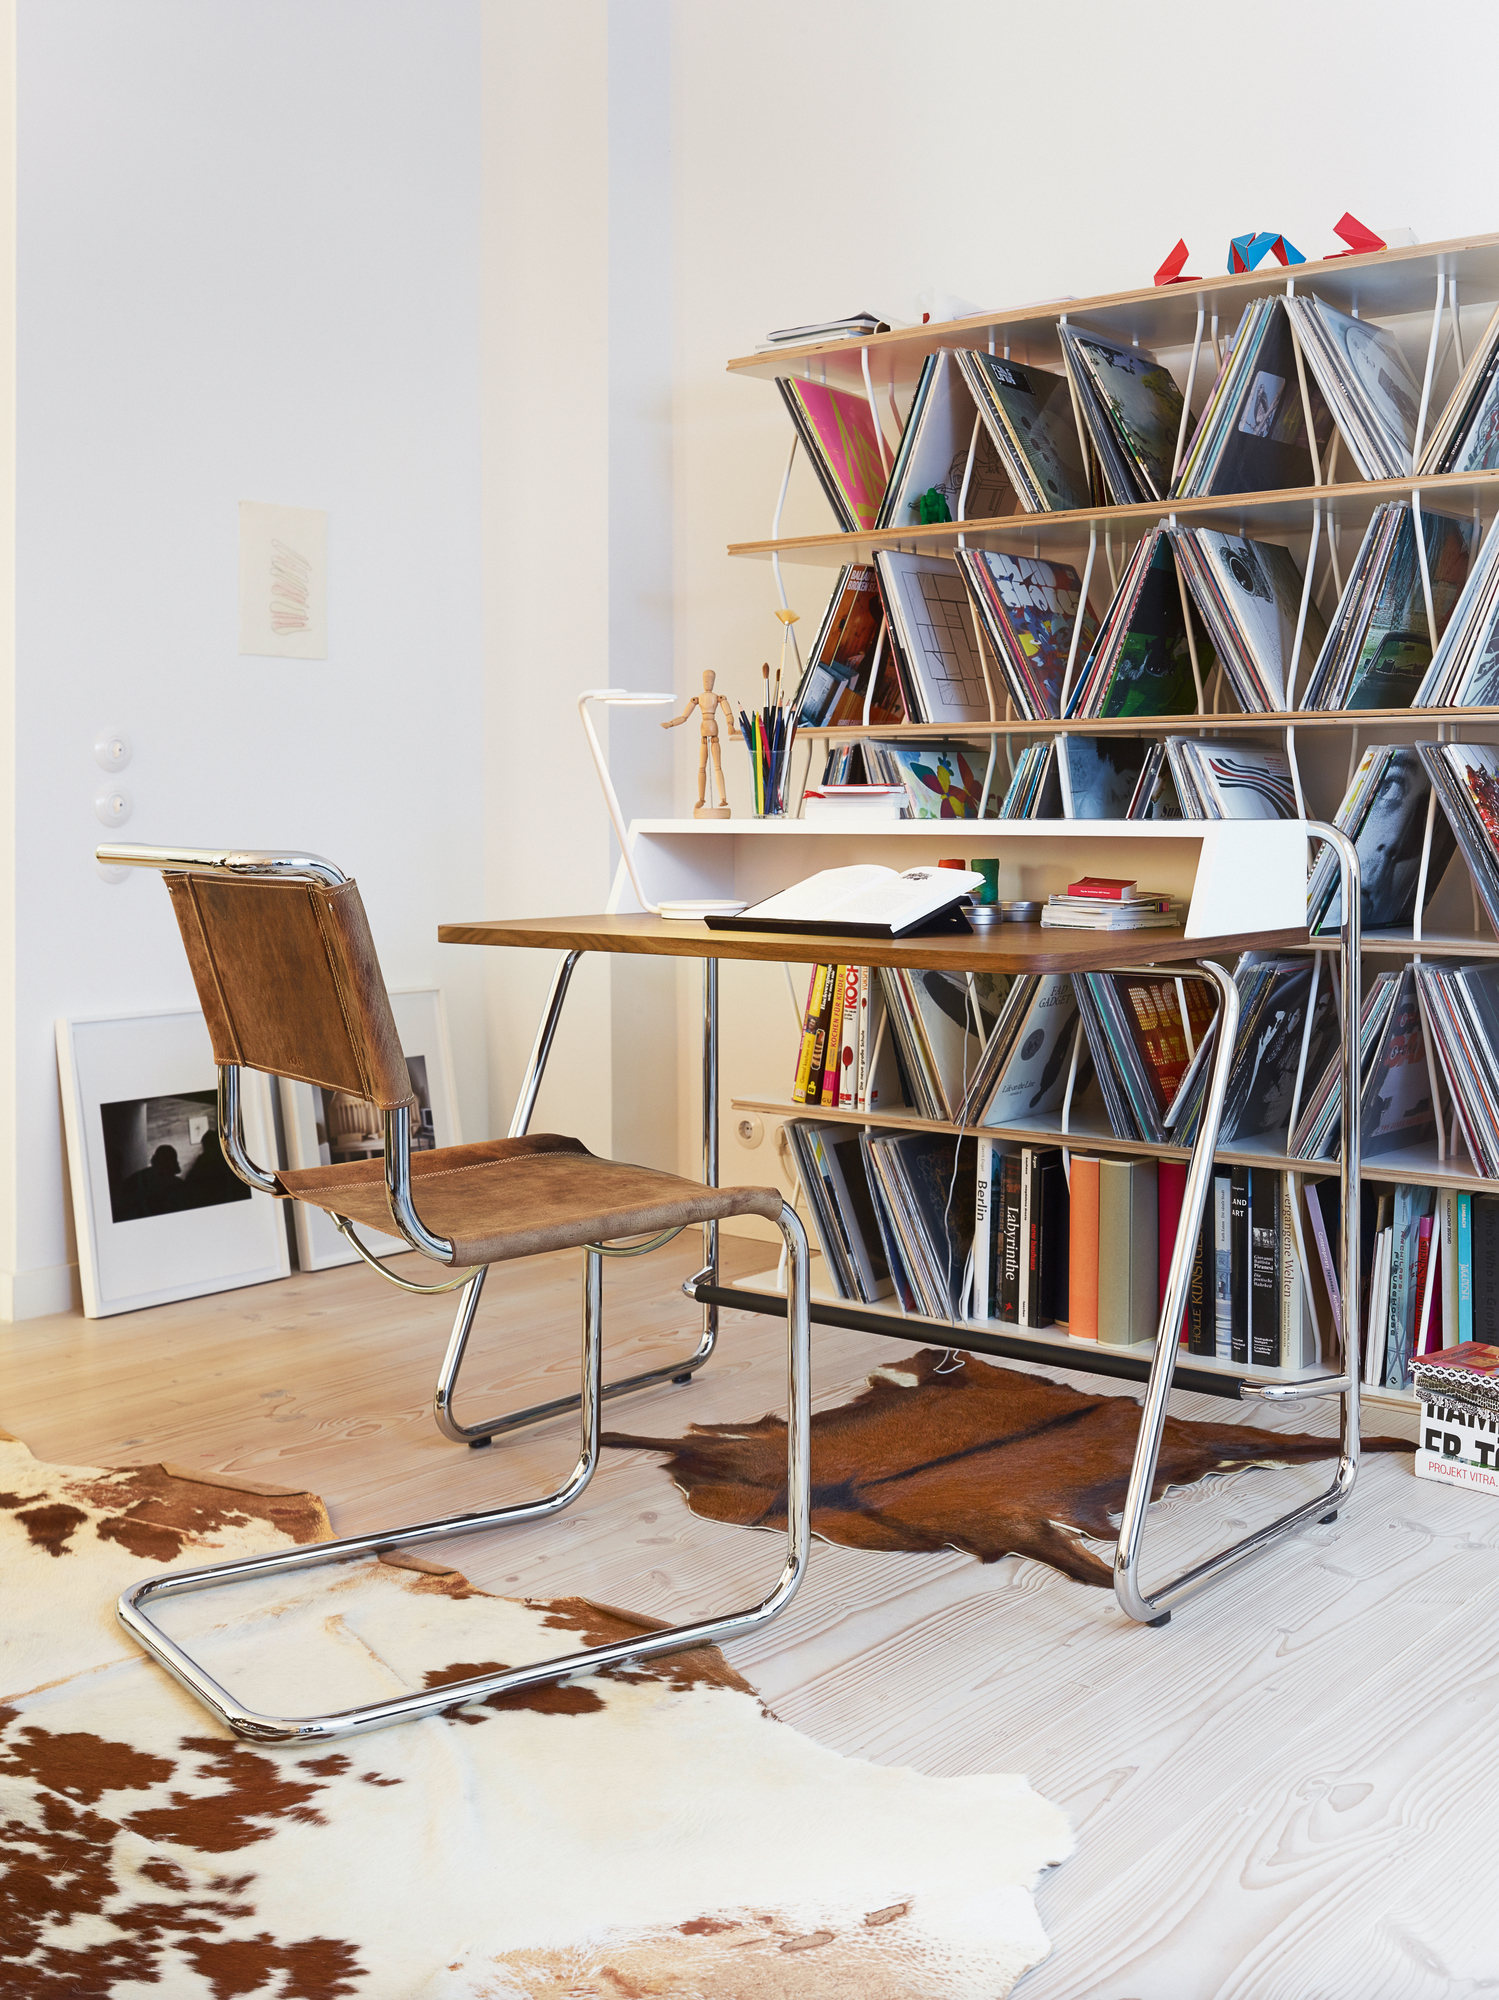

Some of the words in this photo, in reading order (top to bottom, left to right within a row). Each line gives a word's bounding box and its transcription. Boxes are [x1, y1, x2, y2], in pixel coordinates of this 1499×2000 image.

[836, 973, 845, 1001] KINDER
[1039, 994, 1072, 1008] GADGET
[1050, 985, 1068, 997] FAD
[833, 1001, 842, 1017] FÜR
[830, 1018, 840, 1048] KOCHEN
[977, 1180, 988, 1221] Berlin
[1232, 1209, 1244, 1217] ART
[1282, 1193, 1292, 1256] vergangene
[1485, 1210, 1496, 1245] Who's
[1004, 1206, 1020, 1280] Labyrinthe
[1419, 1240, 1428, 1275] Scheins
[1318, 1231, 1329, 1269] Contemporary
[1325, 1269, 1336, 1293] Japanese
[1486, 1251, 1496, 1277] Who
[1284, 1260, 1295, 1298] Welten
[1487, 1282, 1496, 1293] in
[1193, 1309, 1201, 1343] HOLLE
[1428, 1461, 1467, 1479] PROJEKT
